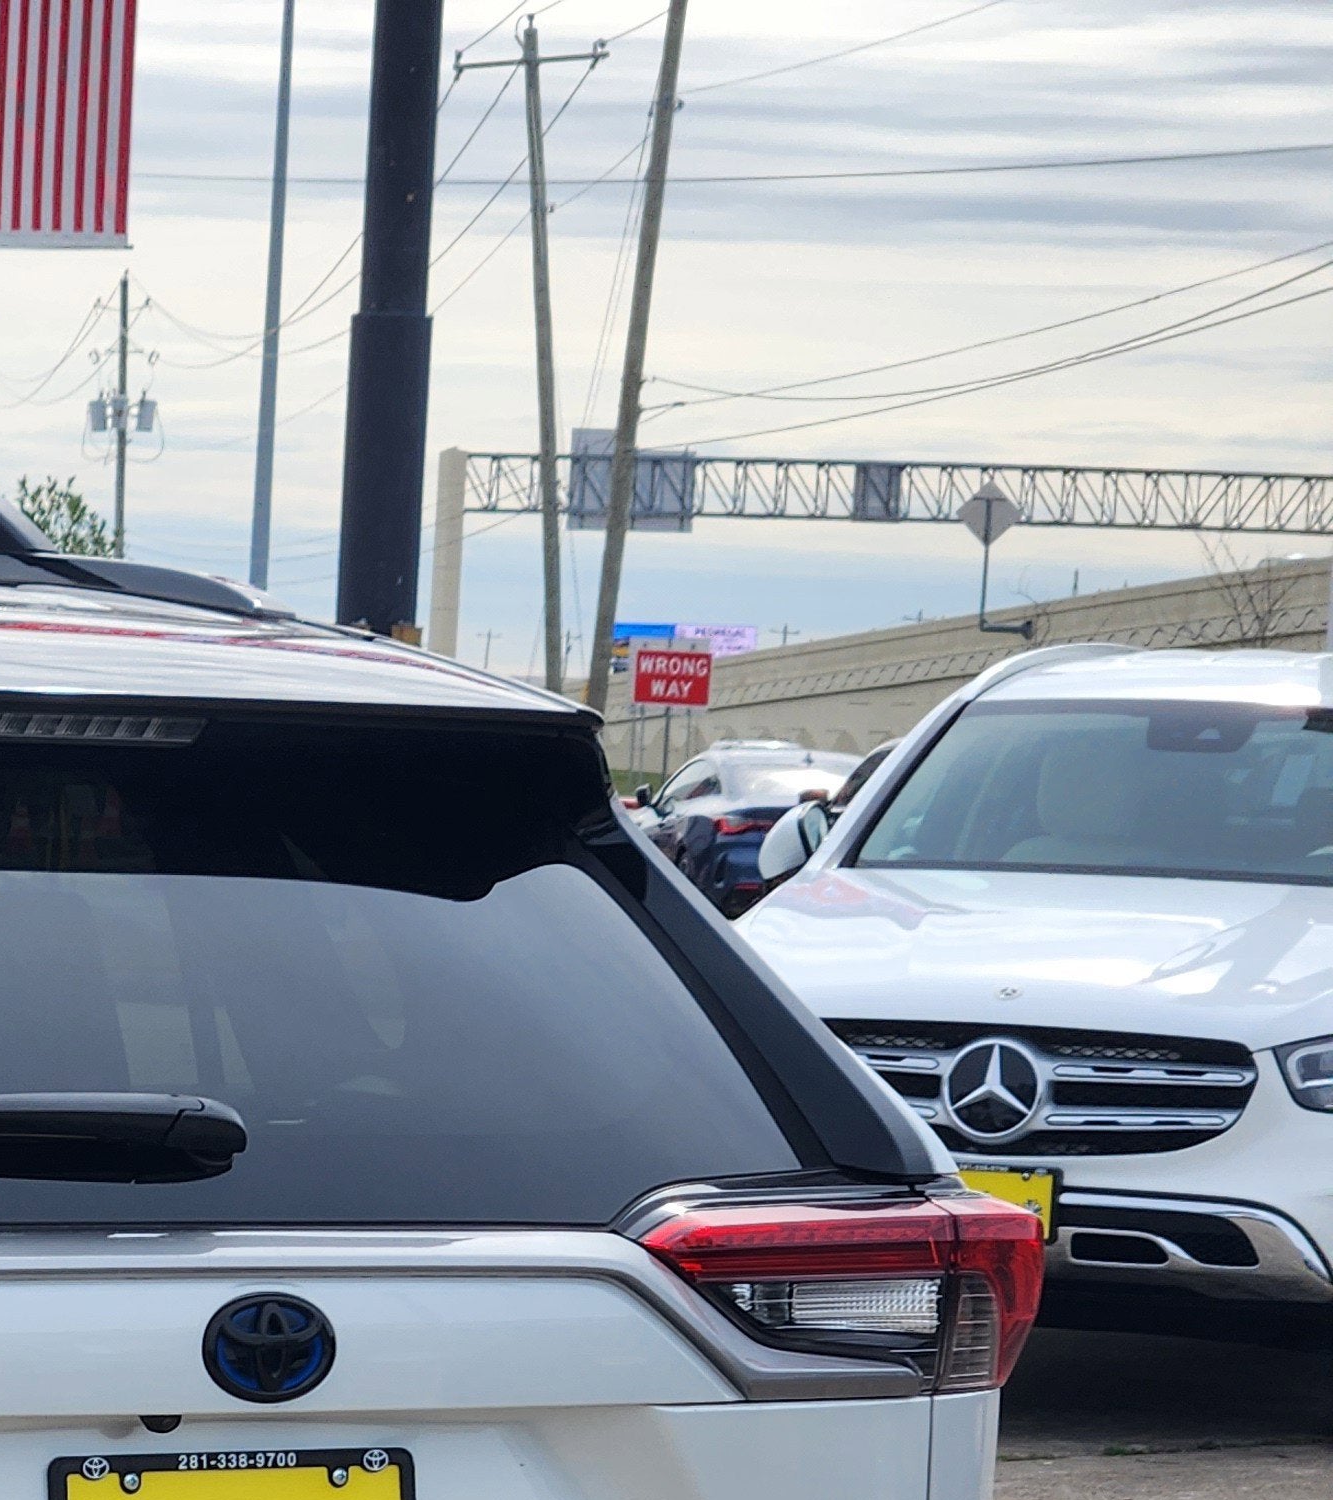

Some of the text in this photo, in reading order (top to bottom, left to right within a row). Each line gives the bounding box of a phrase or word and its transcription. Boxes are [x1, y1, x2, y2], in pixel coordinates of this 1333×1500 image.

[638, 655, 710, 678] WRONG
[650, 678, 694, 699] WAY
[178, 1452, 297, 1470] 281-338-9700
